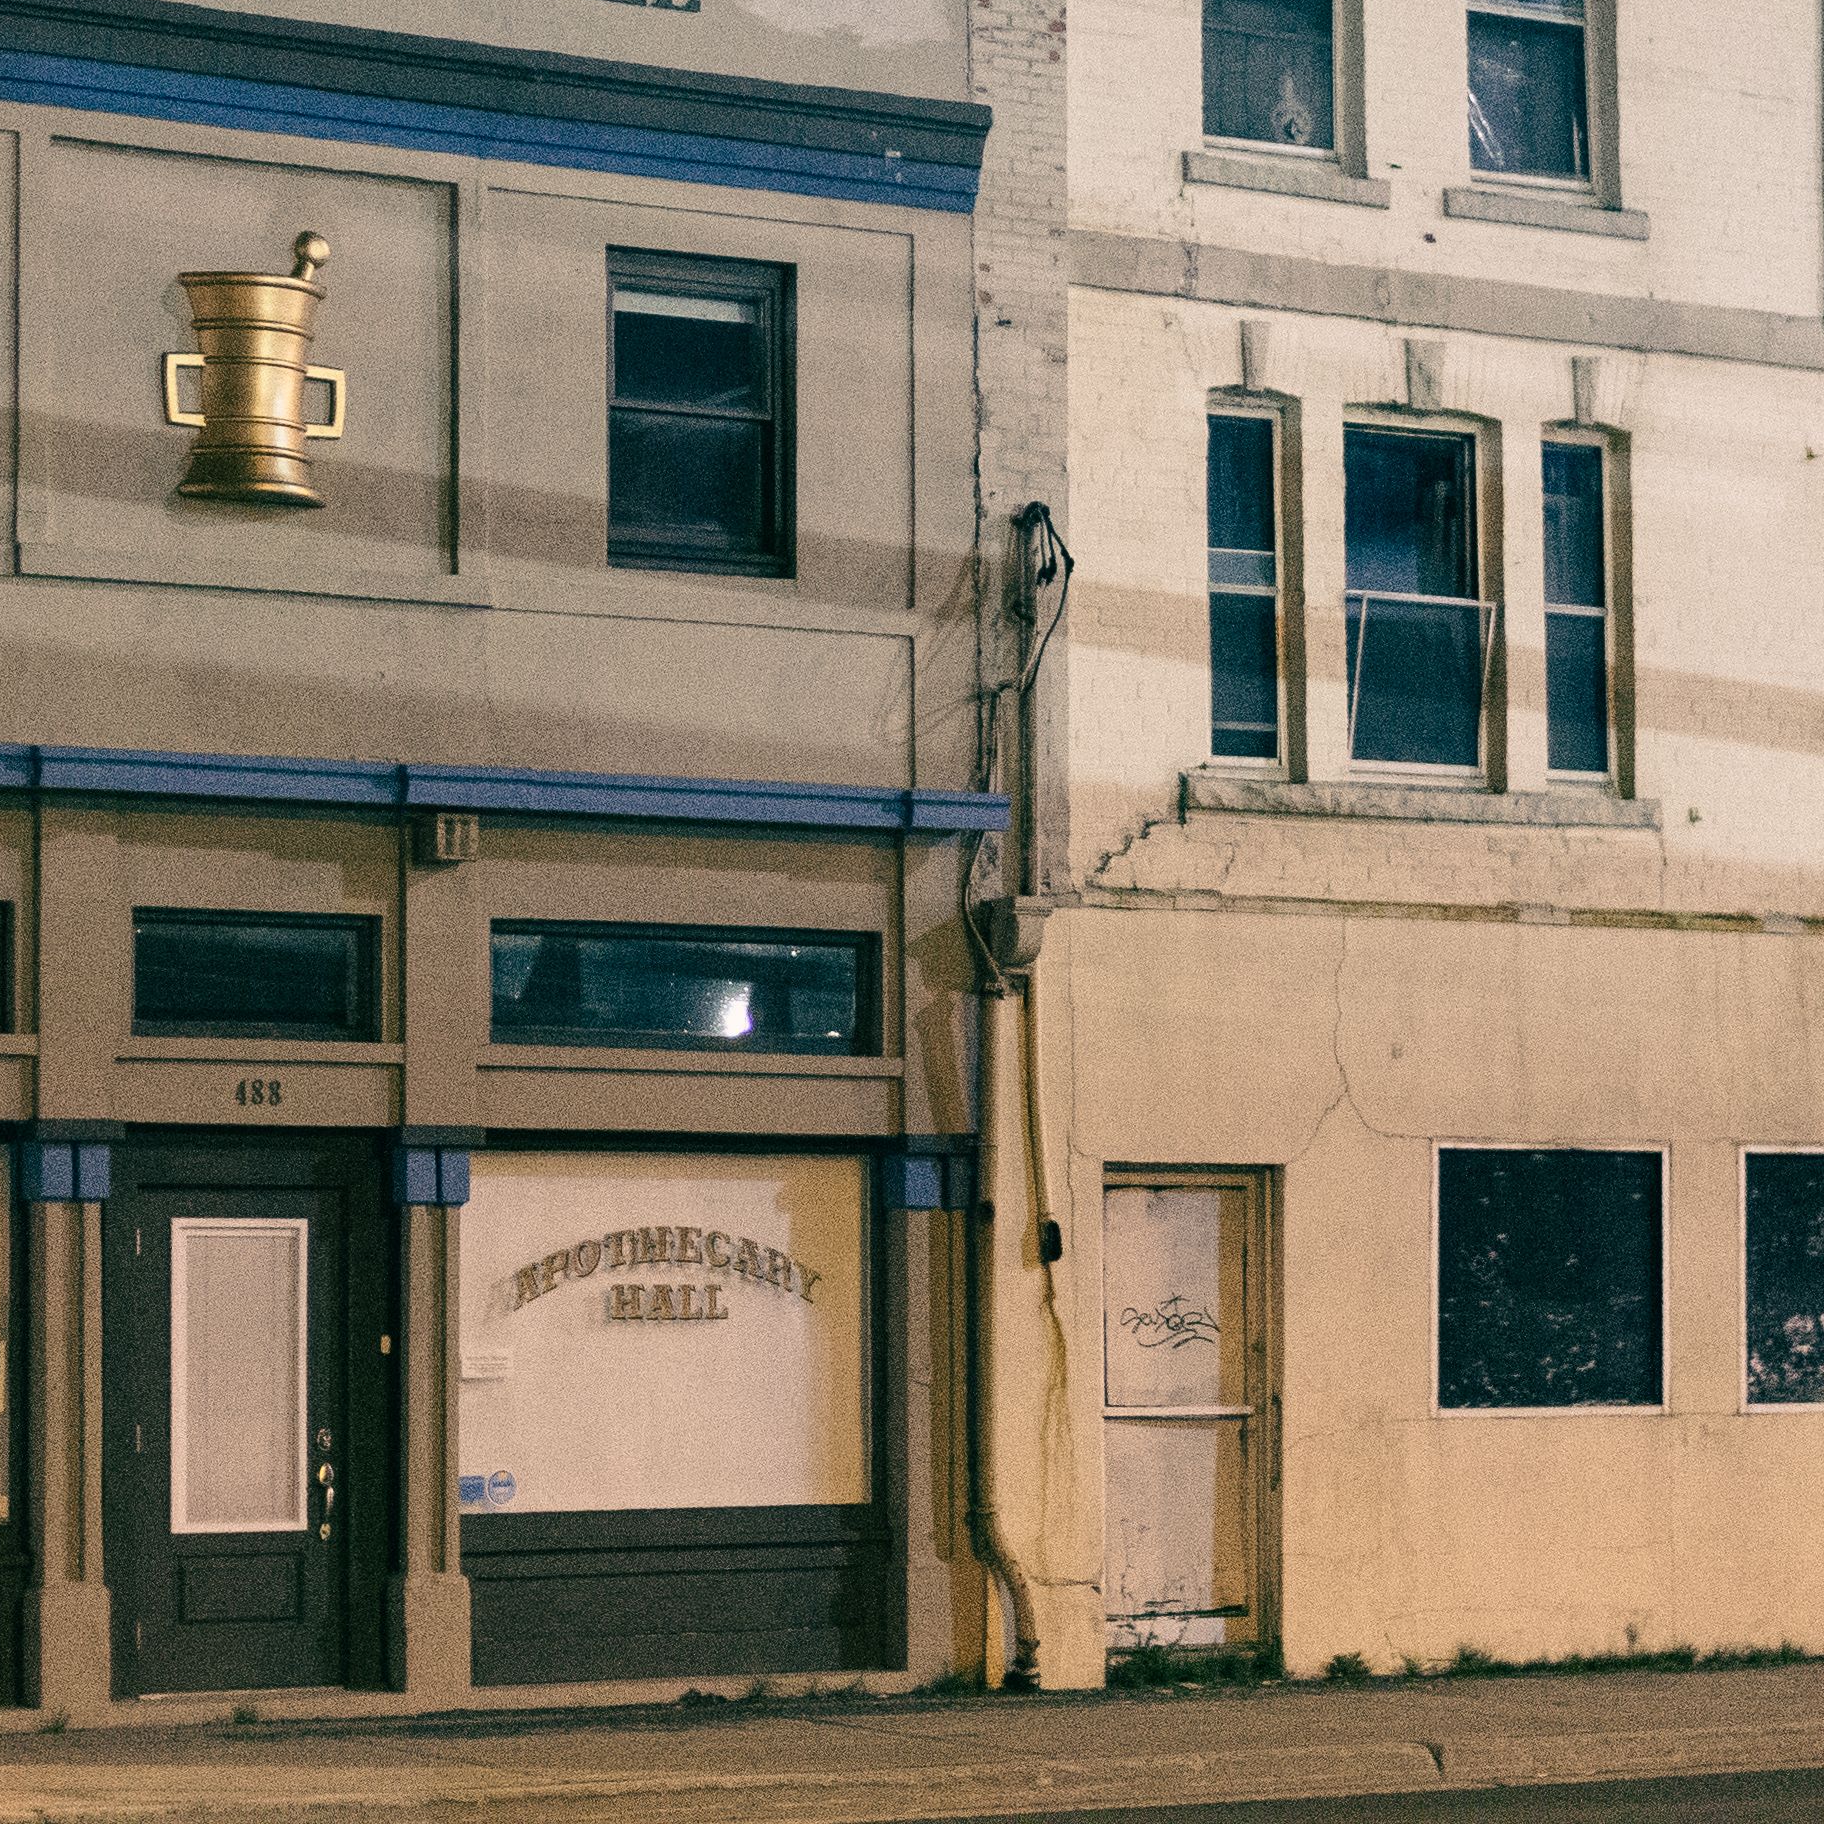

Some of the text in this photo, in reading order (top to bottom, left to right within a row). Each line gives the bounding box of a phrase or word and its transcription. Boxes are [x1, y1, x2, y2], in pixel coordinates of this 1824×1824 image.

[236, 1079, 282, 1106] 488
[513, 1226, 823, 1311] APOTHECARY
[608, 1283, 729, 1321] HALL
